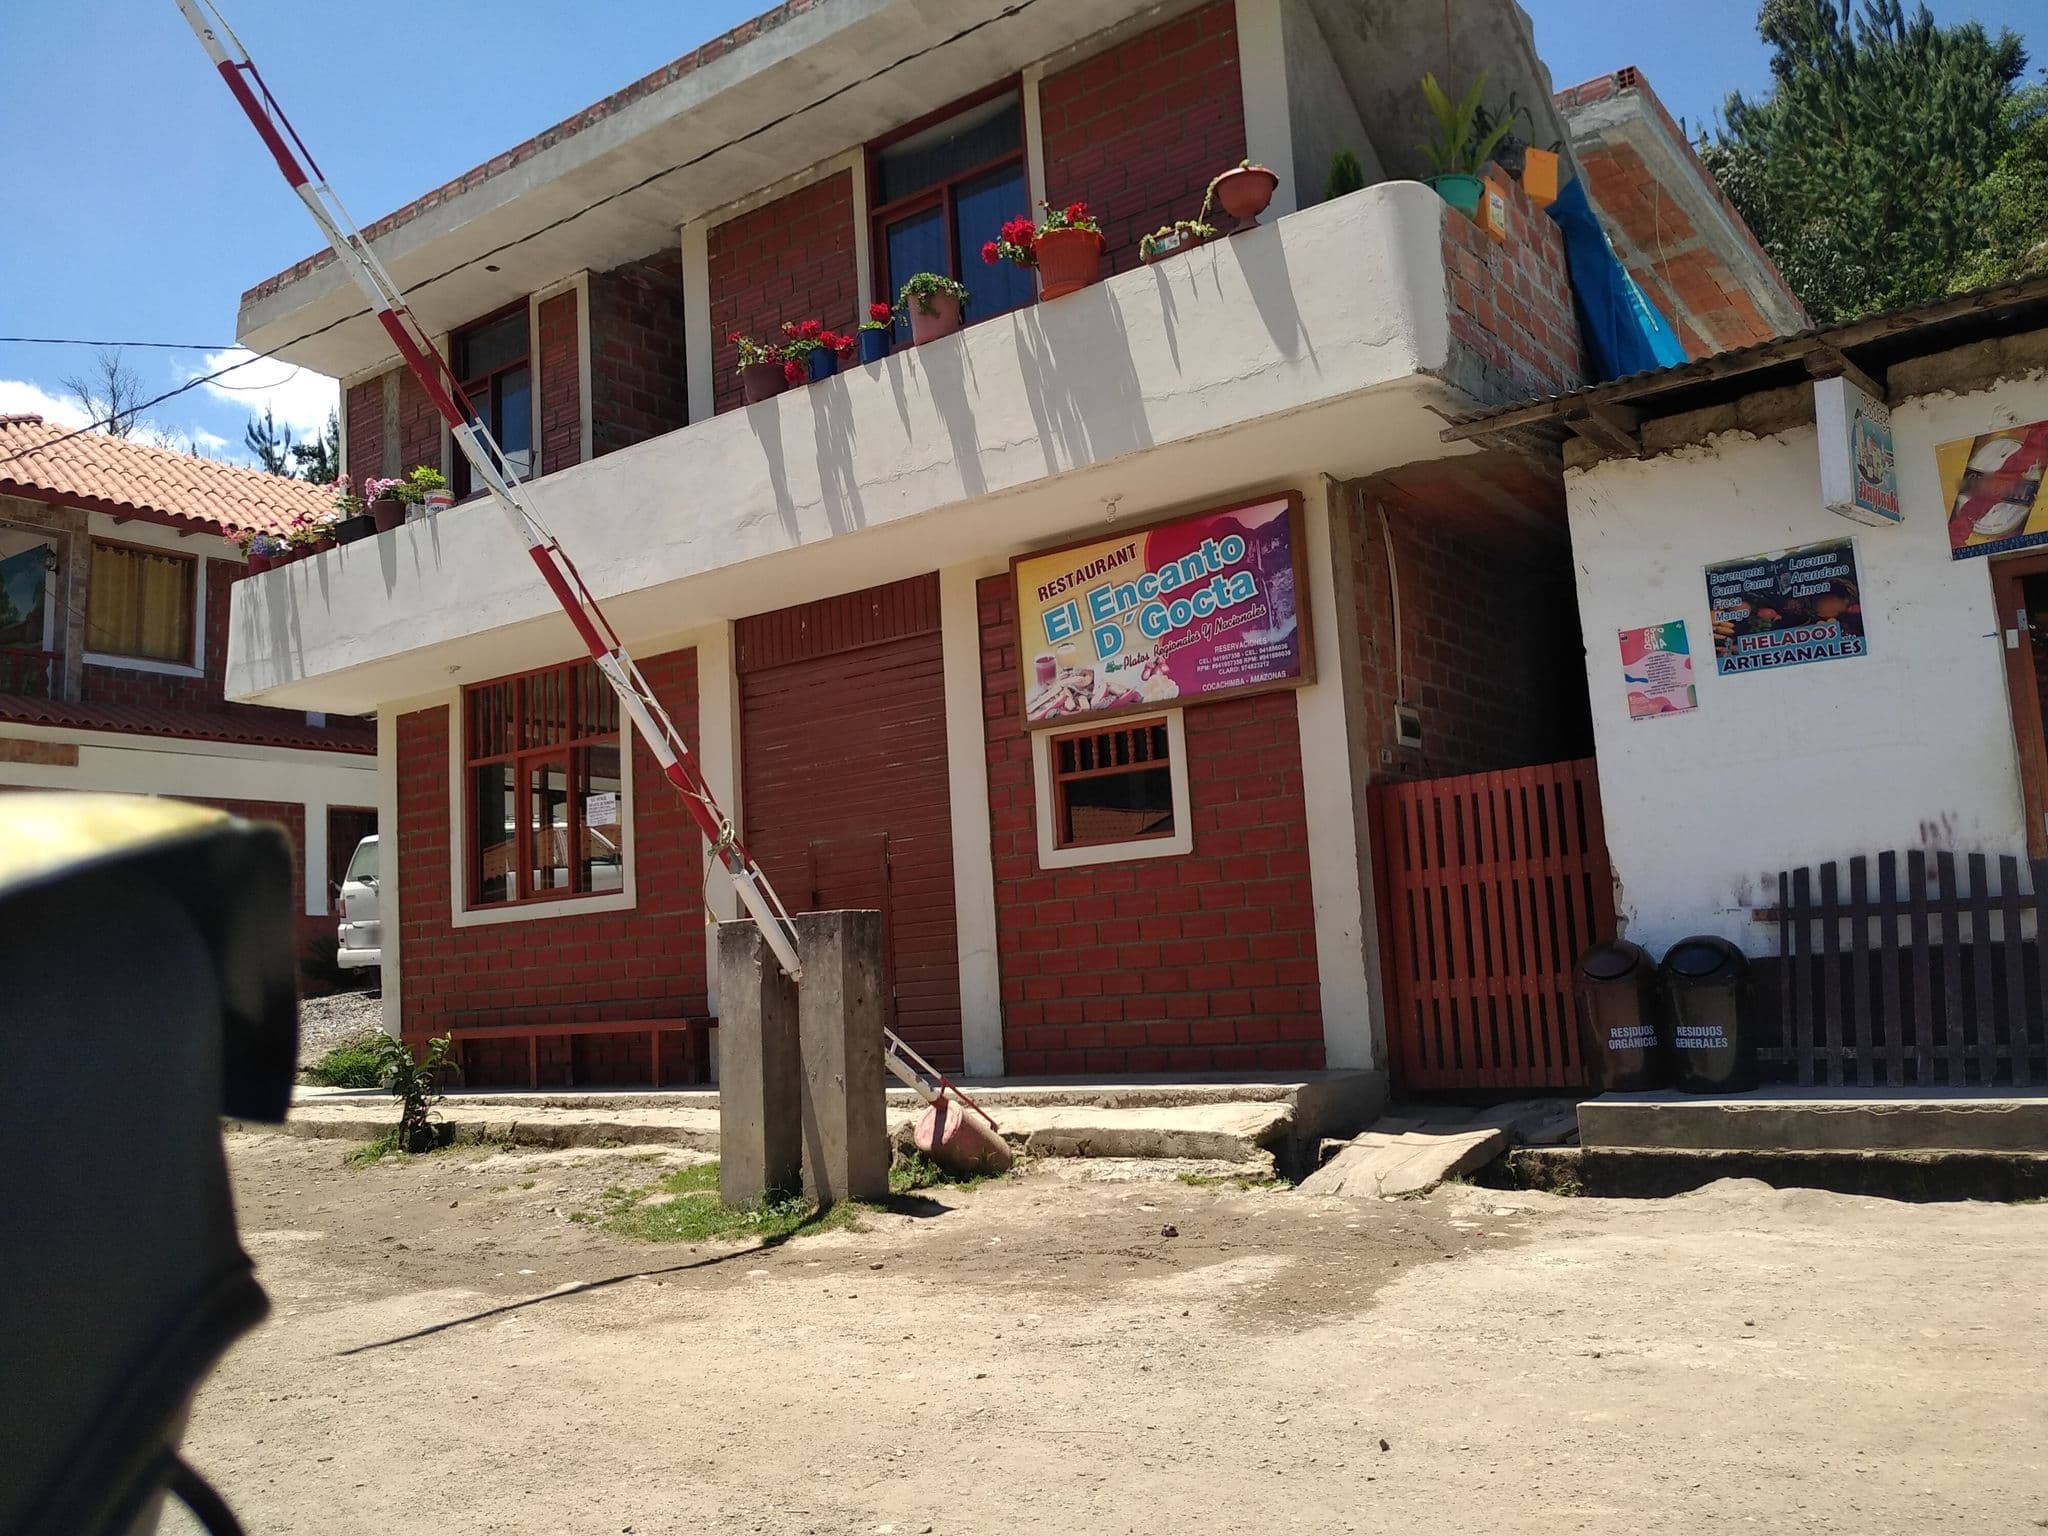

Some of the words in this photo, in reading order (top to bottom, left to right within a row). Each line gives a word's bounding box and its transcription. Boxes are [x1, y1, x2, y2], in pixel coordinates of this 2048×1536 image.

[1789, 553, 1837, 570] Lucuma
[1037, 542, 1136, 602] RESTAURANT
[1791, 564, 1850, 584] Arandano
[1042, 599, 1083, 645] El
[1086, 534, 1246, 625] Encanto
[1712, 585, 1742, 598] Camu
[1743, 577, 1774, 592] Camu
[1713, 596, 1742, 609] Fresa
[1715, 609, 1750, 622] Mango
[1123, 652, 1150, 671] Platos
[1153, 629, 1202, 659] Regionales
[1202, 622, 1213, 643] Y
[1213, 602, 1266, 636] Nacionales
[1214, 636, 1268, 654] RESERVACIONES
[1741, 625, 1837, 651] HELADOS
[1723, 640, 1862, 672] ARTESANALES
[1202, 678, 1245, 691] COCACHIMBA
[1250, 670, 1287, 684] AMAZONAS
[1610, 1025, 1654, 1038] RESIDUOS
[1676, 1025, 1723, 1037] RESIDUOS
[1675, 1037, 1729, 1048] GENERALES
